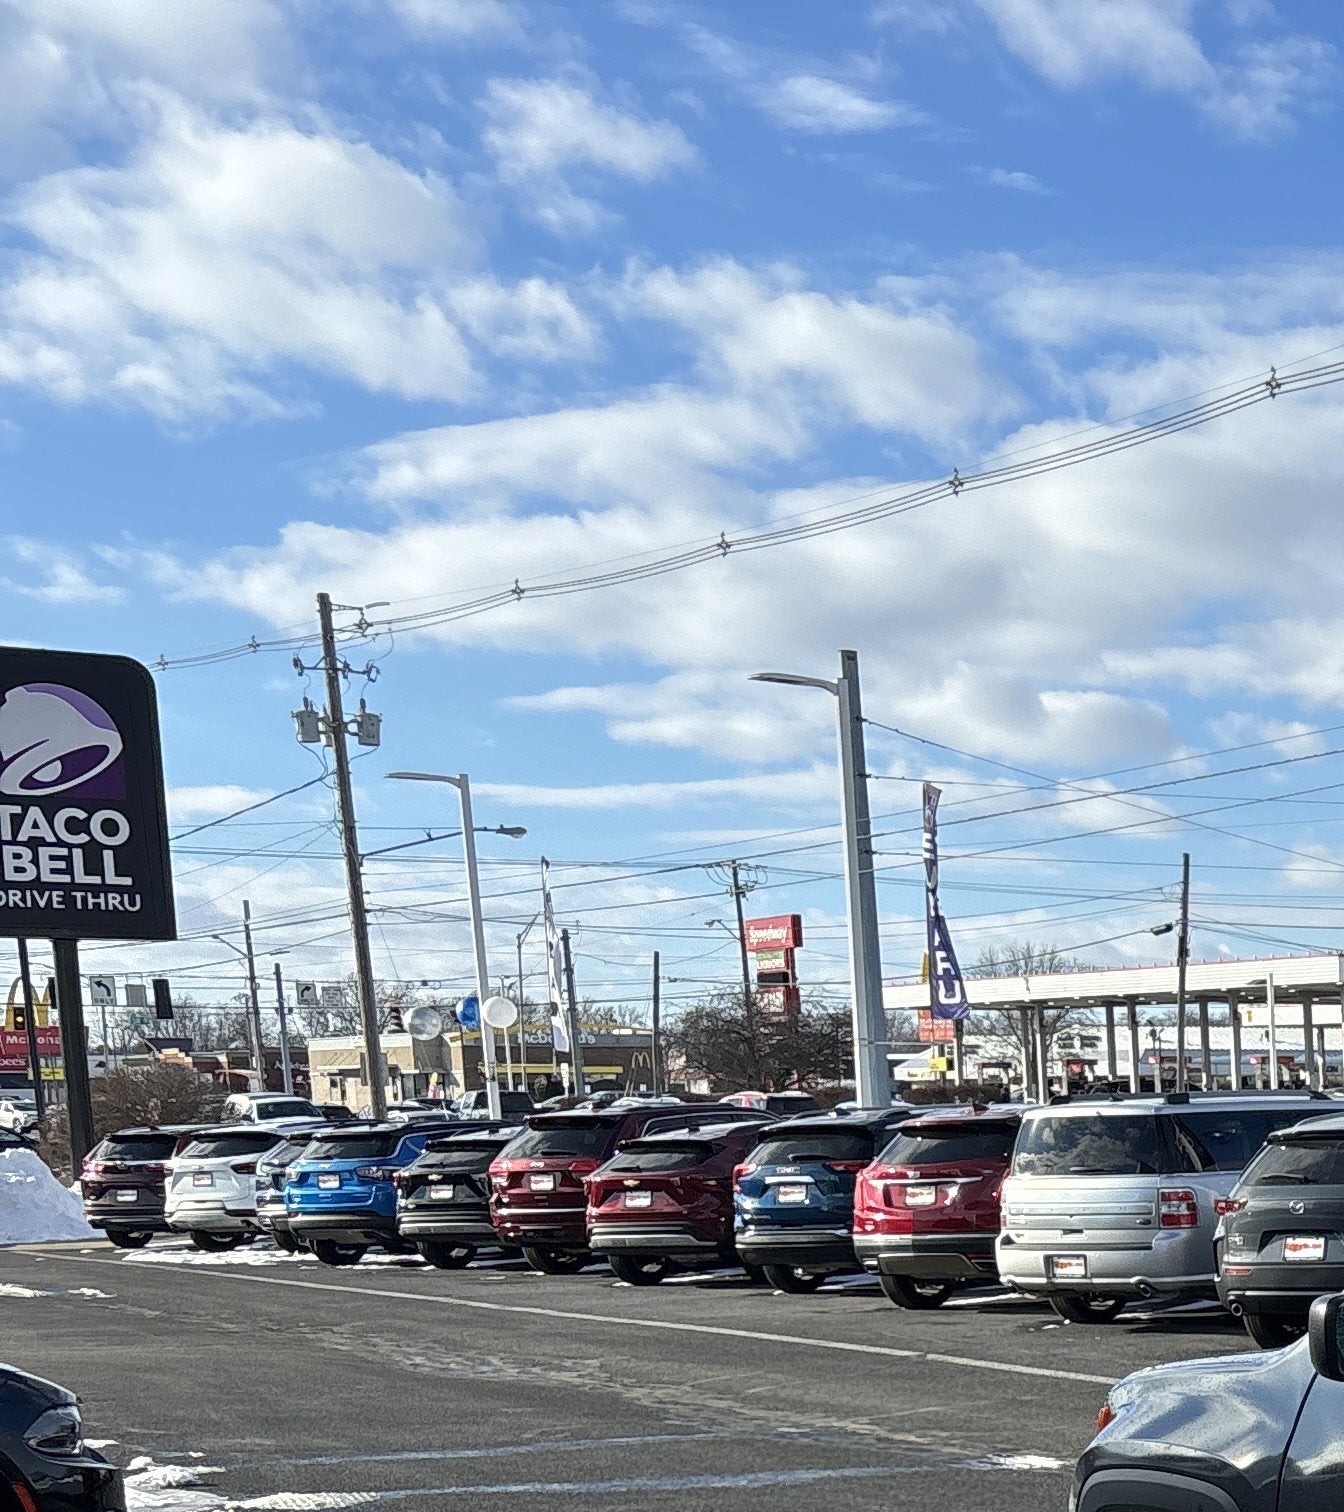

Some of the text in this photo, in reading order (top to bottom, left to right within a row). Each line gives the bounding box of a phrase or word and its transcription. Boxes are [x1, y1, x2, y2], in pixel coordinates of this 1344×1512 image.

[0, 804, 131, 846] TACO
[2, 844, 133, 885] BELL
[71, 891, 141, 912] THRU
